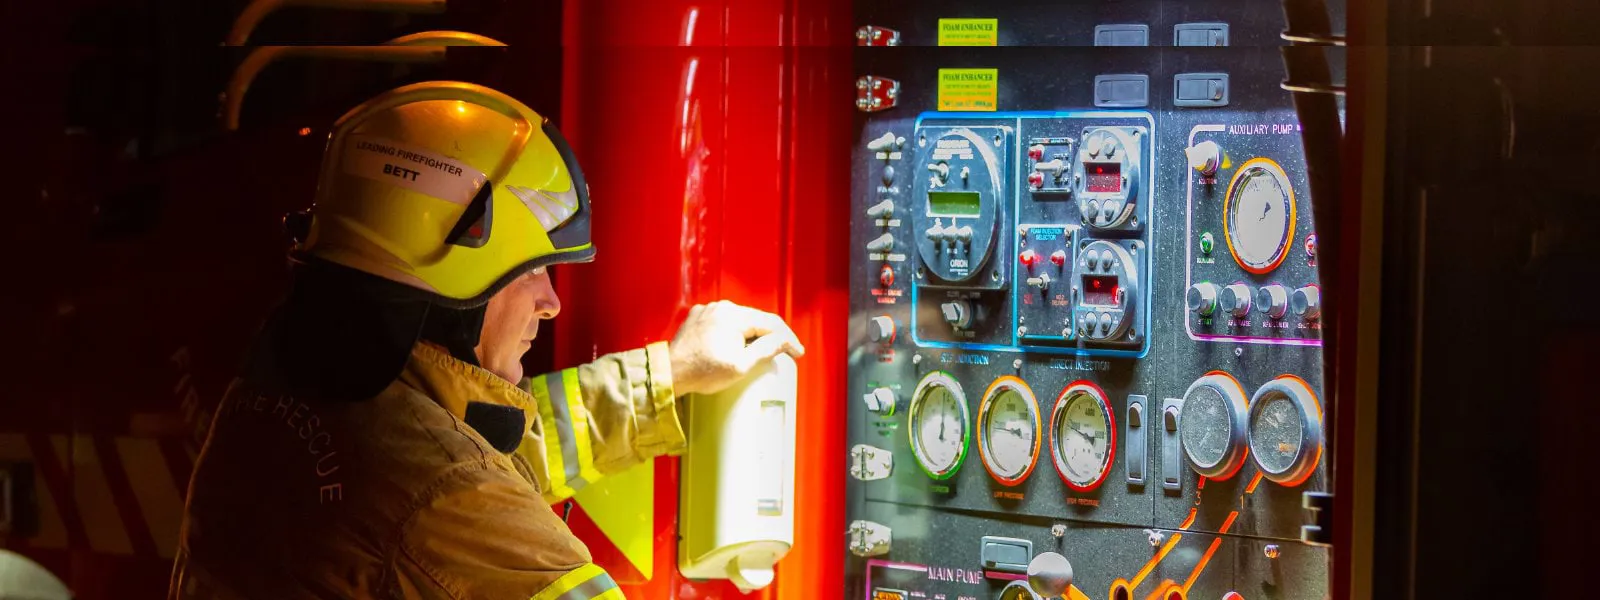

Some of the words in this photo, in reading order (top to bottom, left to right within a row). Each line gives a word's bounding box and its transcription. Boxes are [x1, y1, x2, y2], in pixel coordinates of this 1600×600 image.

[1229, 124, 1269, 135] AUXILIARY
[1272, 124, 1293, 135] PUMP
[356, 141, 395, 156] LEADING
[397, 149, 463, 177] FIREFIGHTER
[383, 163, 420, 181] BETT
[271, 393, 343, 505] RESCUE
[928, 566, 954, 582] MAIN
[956, 568, 982, 585] PUMP
